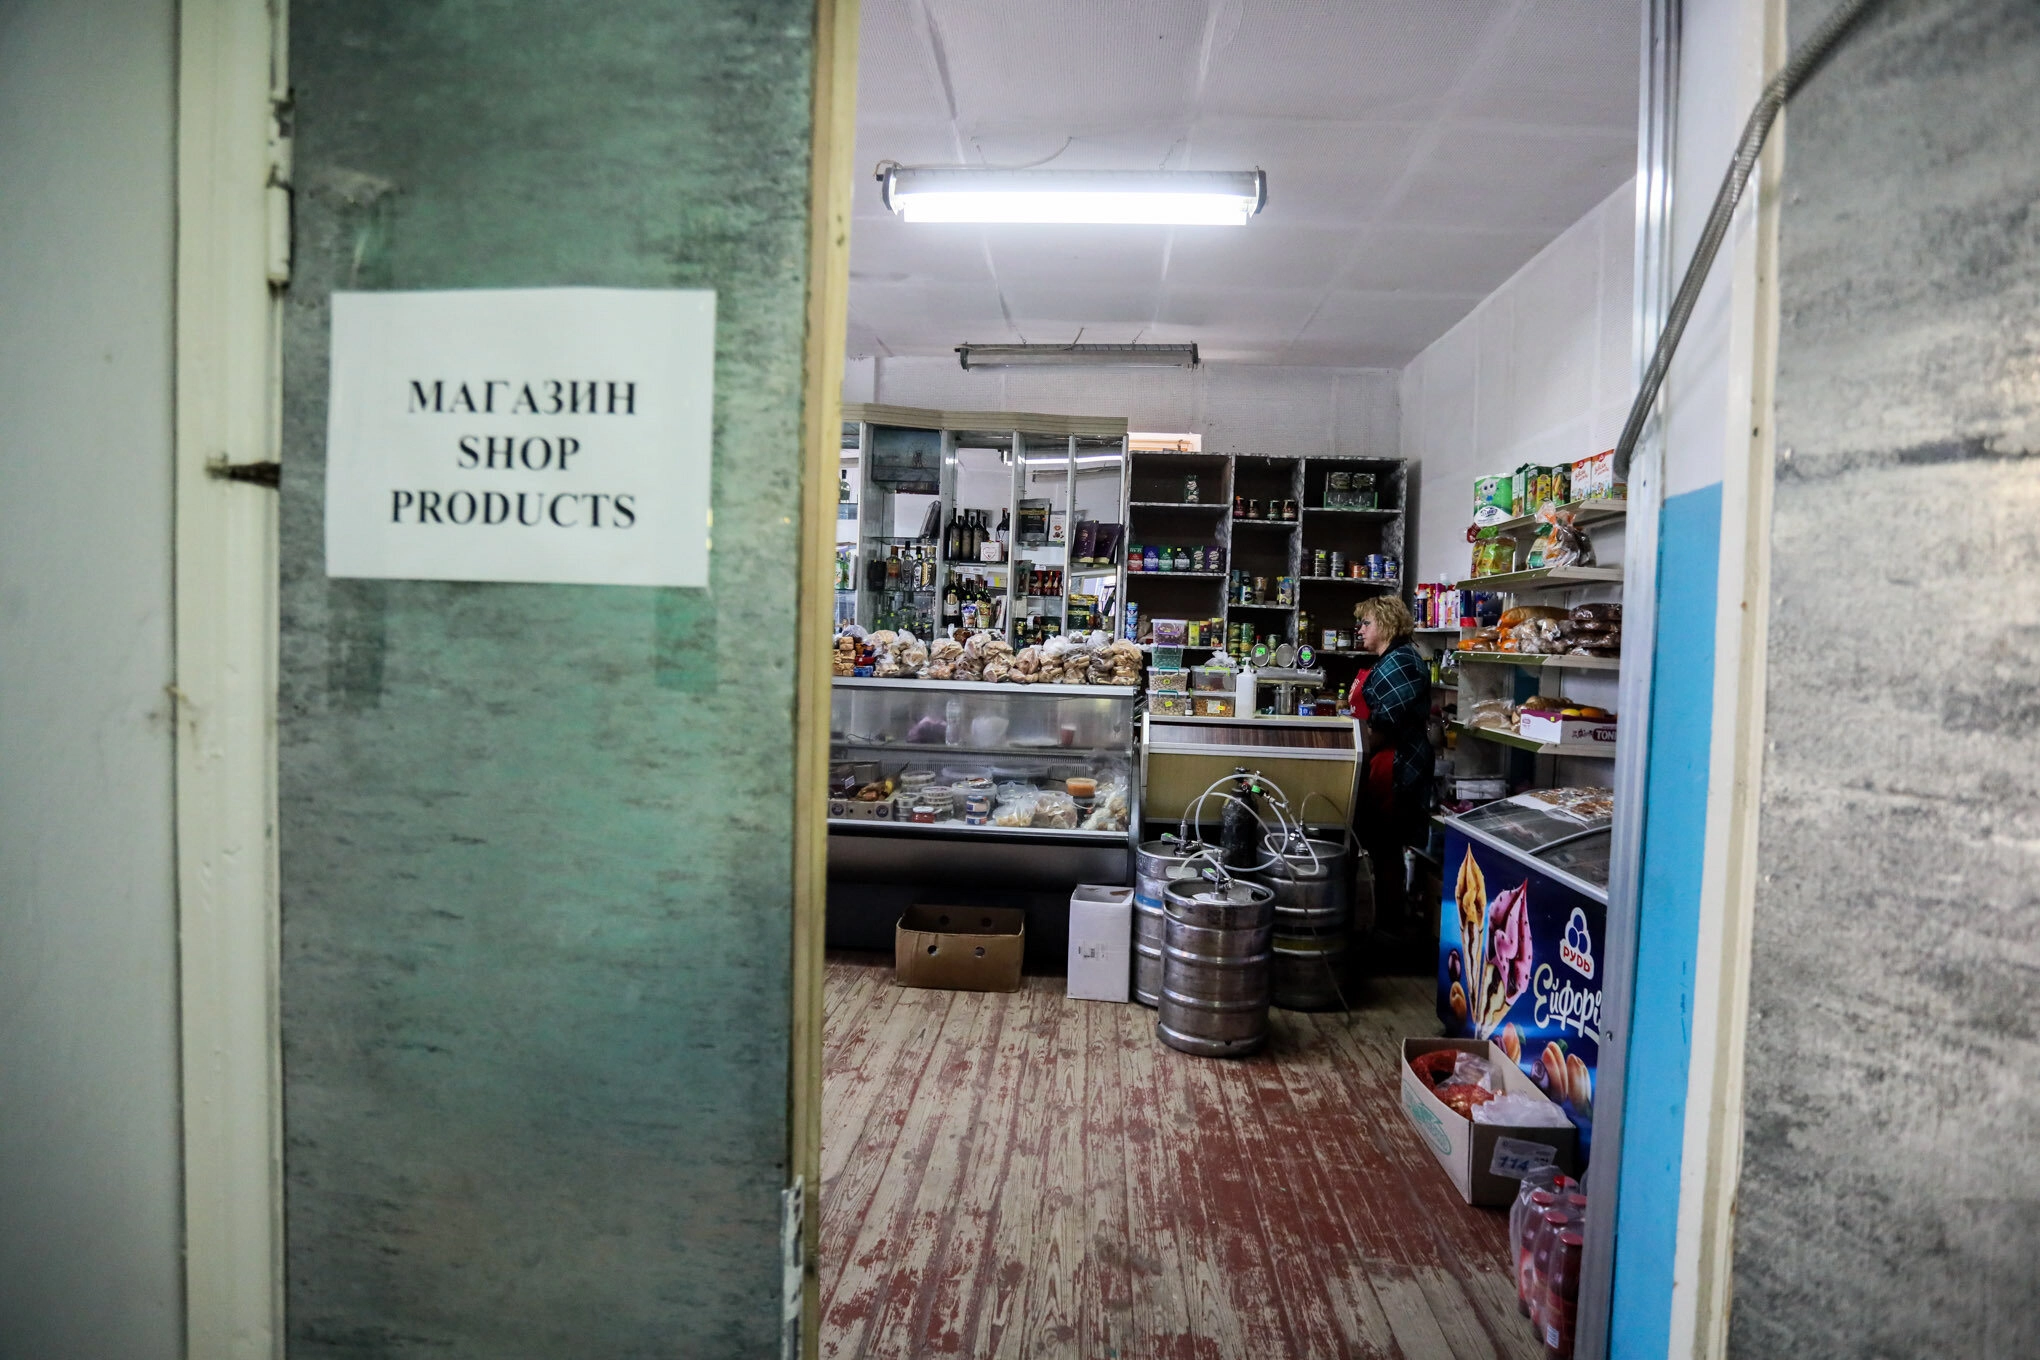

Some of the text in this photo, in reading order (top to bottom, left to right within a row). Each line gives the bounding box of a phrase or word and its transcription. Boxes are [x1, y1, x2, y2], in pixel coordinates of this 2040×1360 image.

[408, 379, 638, 415] МАГАЗИН
[457, 434, 581, 470] SHOP
[390, 490, 636, 529] PRODUCTS
[1533, 963, 1602, 1038] Ейфорі
